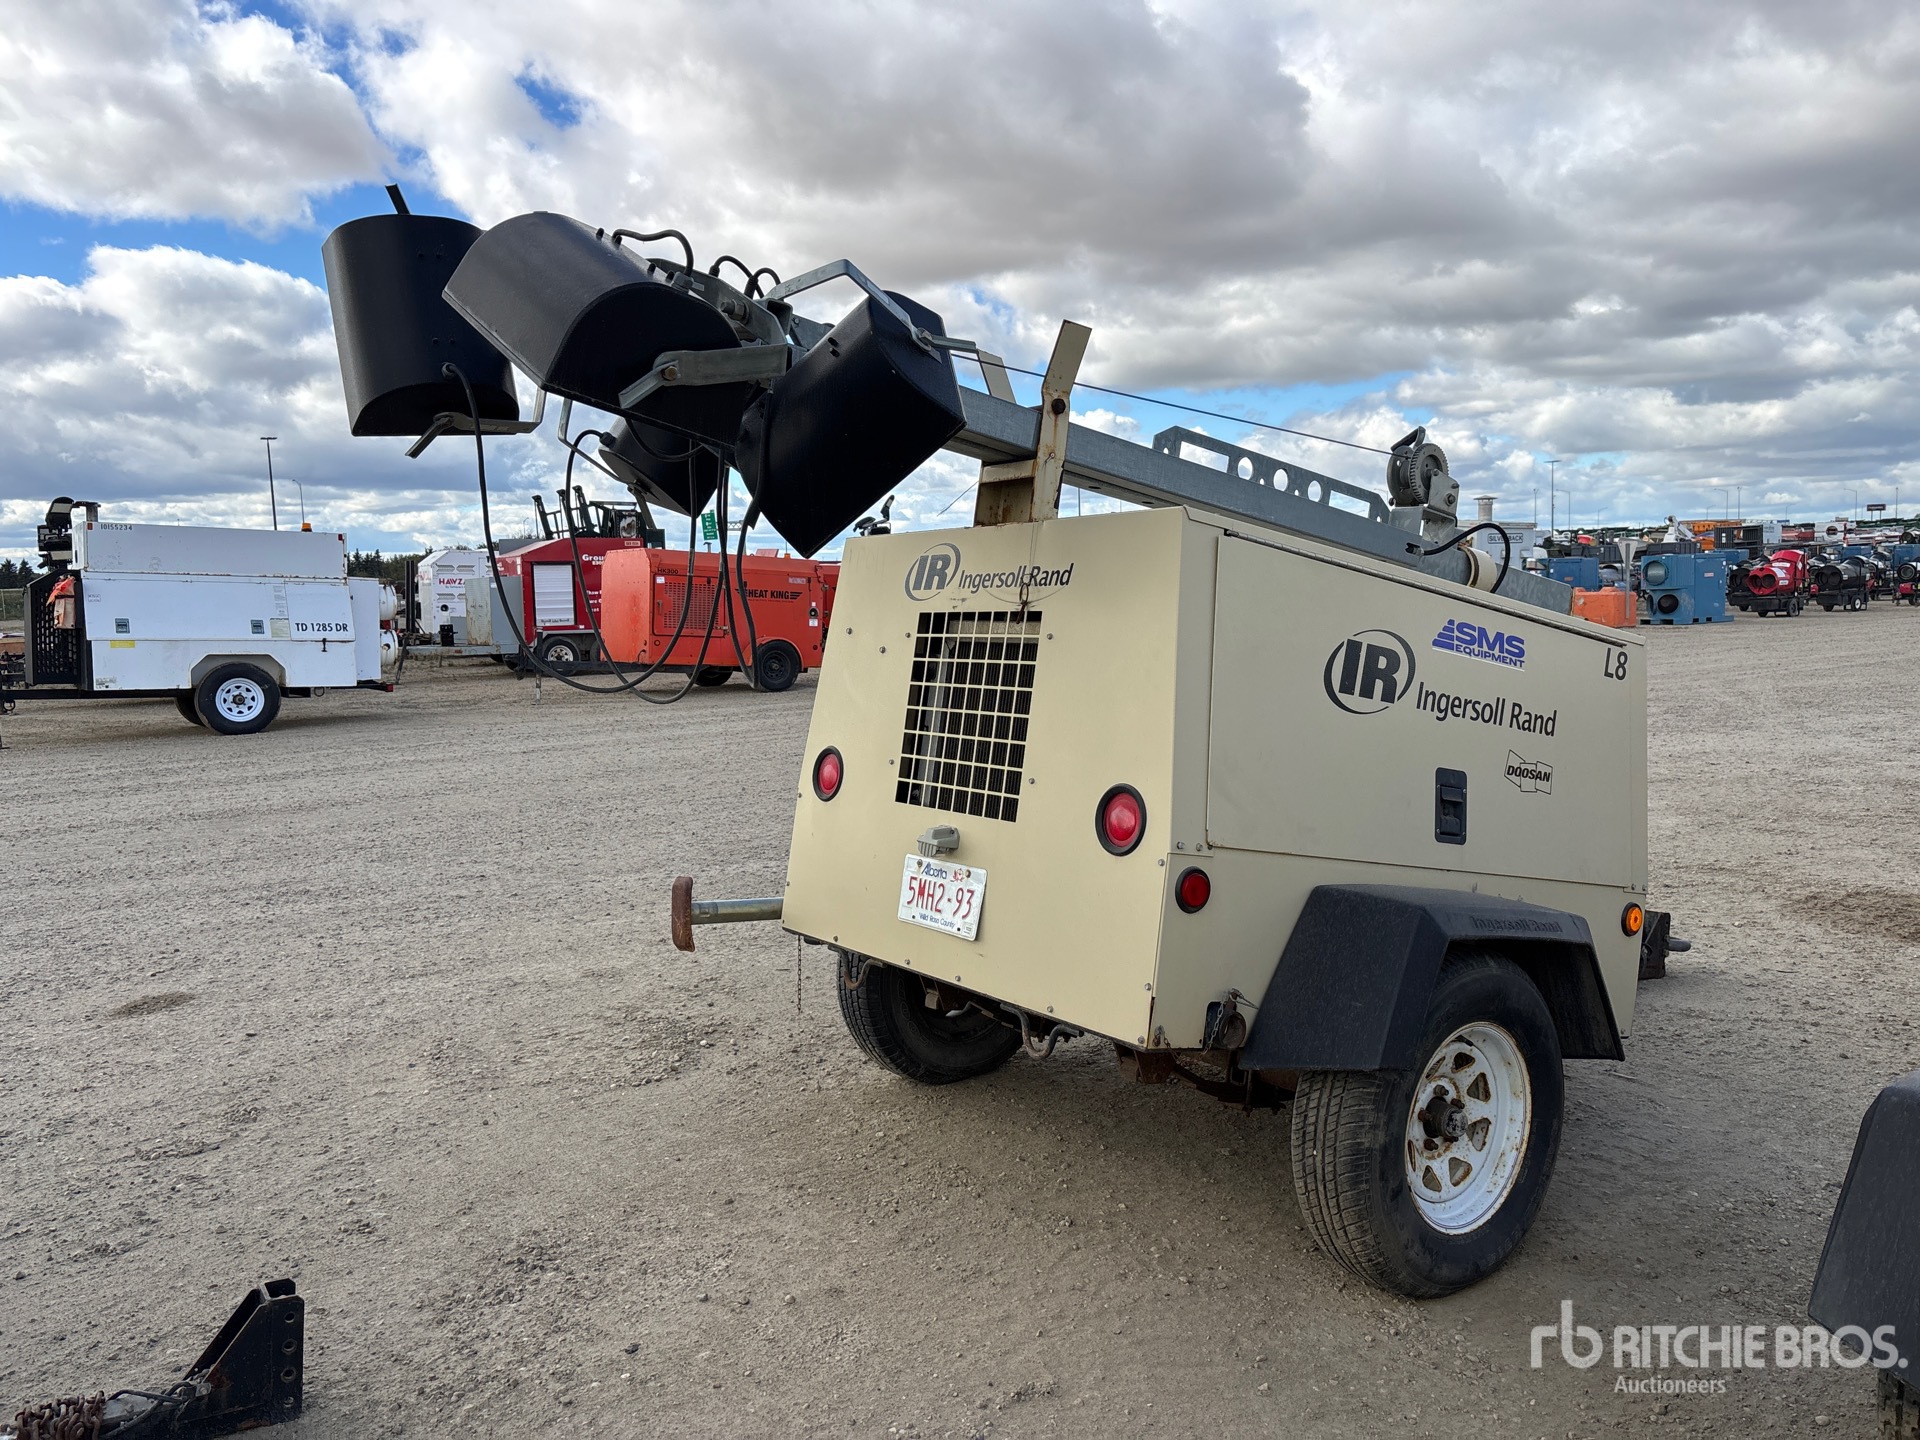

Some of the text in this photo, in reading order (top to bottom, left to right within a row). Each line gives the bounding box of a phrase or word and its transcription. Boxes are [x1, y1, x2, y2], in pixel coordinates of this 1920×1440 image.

[582, 553, 604, 562] Grou
[958, 562, 1074, 594] Ingersoll Rand
[748, 589, 790, 600] HEAT KING
[295, 622, 308, 632] TD
[310, 622, 333, 632] 1285
[335, 622, 349, 632] DR
[1455, 621, 1525, 658] SMS
[1455, 644, 1525, 668] EQUIPMENT
[1603, 647, 1628, 681] L8
[1338, 638, 1401, 704] IR
[1416, 682, 1557, 737] Ingersoll Rand
[1506, 765, 1551, 782] DOOSAN
[921, 862, 948, 880] Alberta
[907, 876, 975, 920] 5MH2-93
